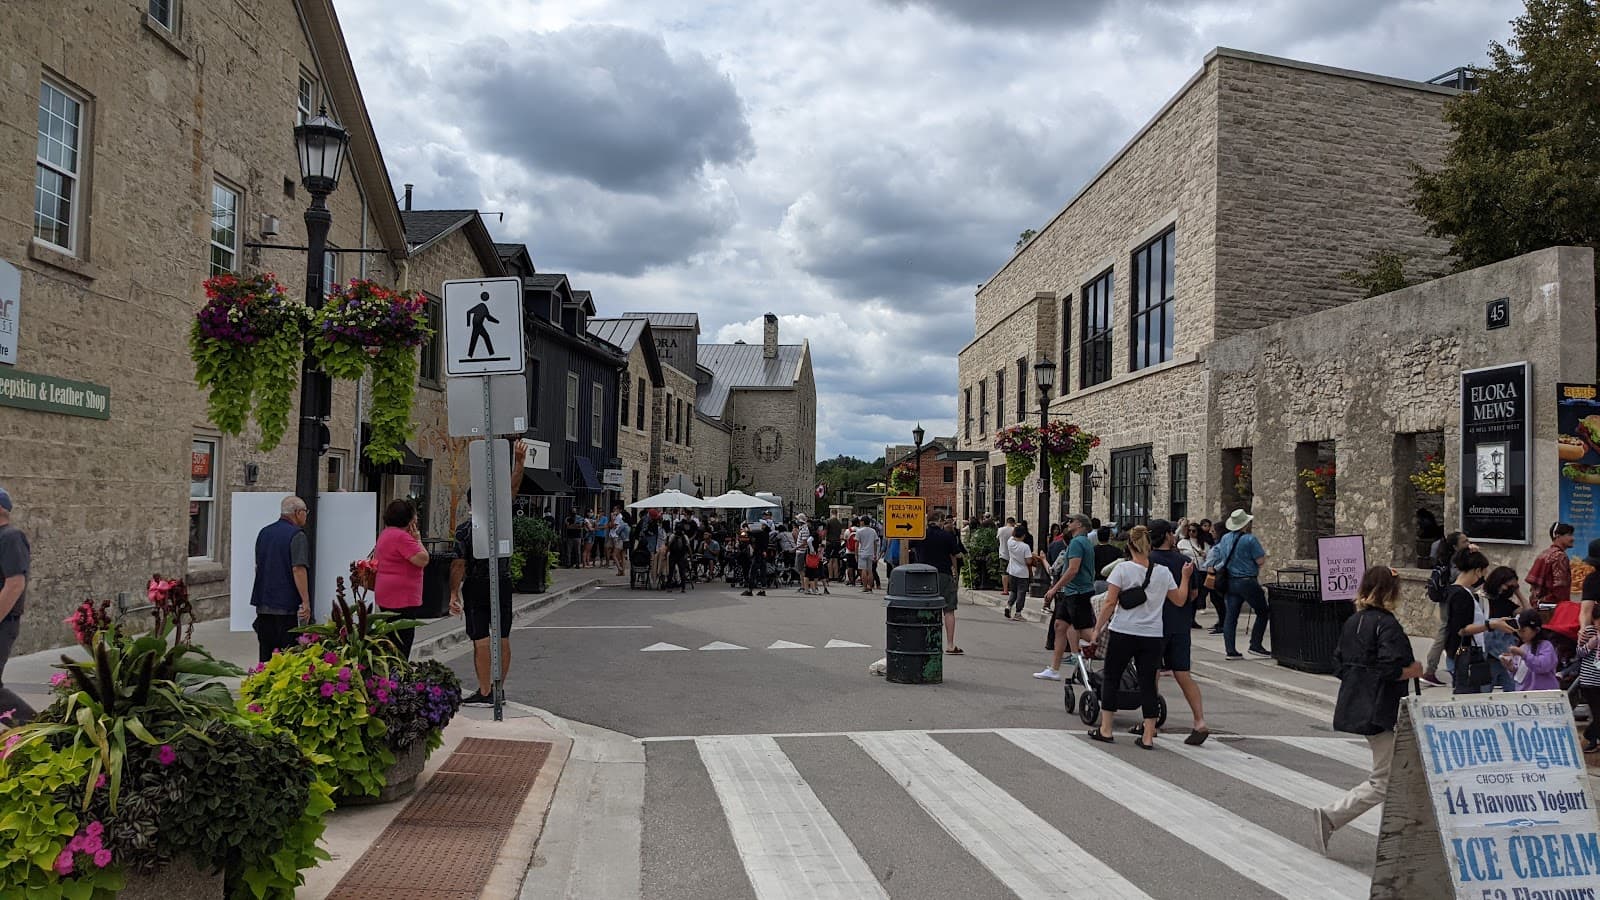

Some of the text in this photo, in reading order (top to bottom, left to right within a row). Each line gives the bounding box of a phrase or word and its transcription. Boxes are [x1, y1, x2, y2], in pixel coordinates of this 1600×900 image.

[1490, 304, 1504, 321] 45
[39, 382, 48, 401] &
[50, 383, 84, 407] Leather
[85, 390, 106, 412] Shop
[1471, 382, 1517, 403] ELORA
[1473, 401, 1514, 420] MEWS
[1469, 505, 1519, 515] eloramews.com
[1327, 556, 1341, 565] buy
[1329, 564, 1341, 575] get
[1422, 702, 1566, 718] FRESH BLENDED LOW FAT
[1424, 721, 1582, 775] Frozen Yogurt
[1476, 773, 1546, 784] CHOOSE FROM
[1443, 785, 1588, 815] 14 Flavours Yogurt
[1451, 832, 1600, 882] ICE CREAM
